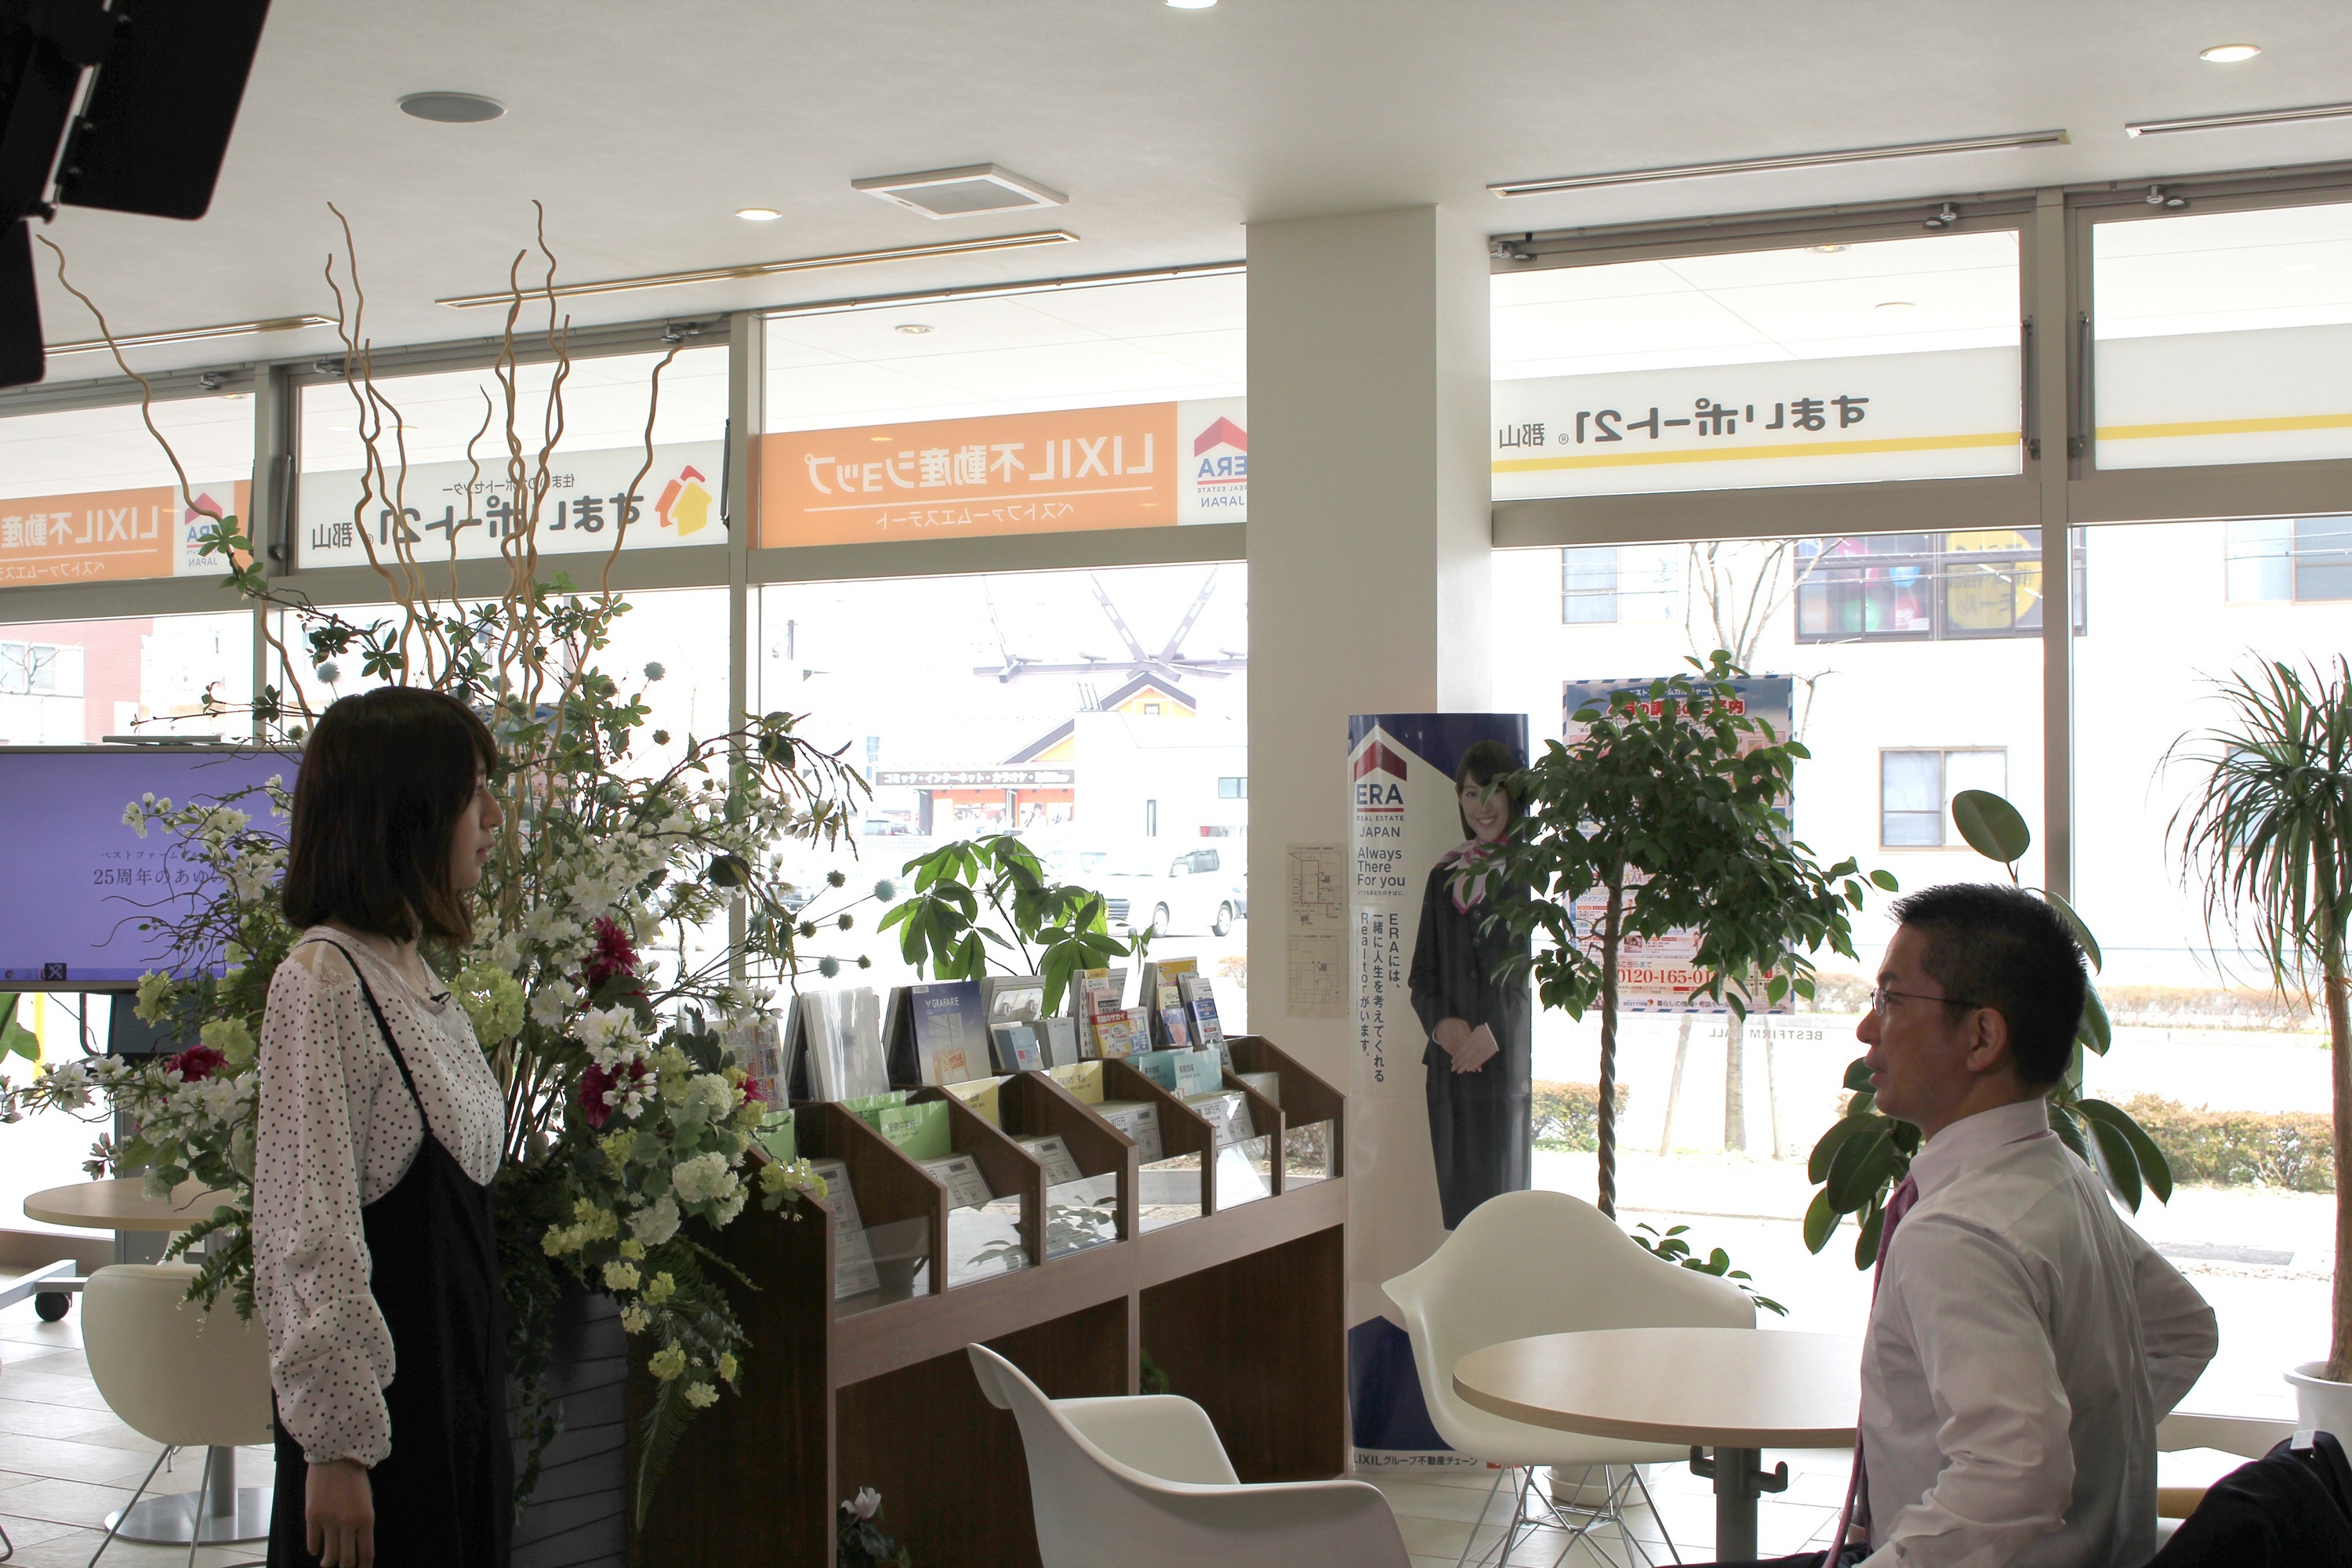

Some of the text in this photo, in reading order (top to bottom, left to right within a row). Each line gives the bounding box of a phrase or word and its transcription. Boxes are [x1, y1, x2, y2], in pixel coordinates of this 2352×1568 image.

[1356, 784, 1403, 805] ERA
[1359, 826, 1400, 838] JAPAN
[1358, 847, 1403, 862] Always
[1358, 861, 1392, 873] There
[1358, 874, 1406, 888] For you
[1618, 968, 1717, 984] 0120-165-01
[931, 996, 960, 1008] GRAFARE
[1373, 914, 1385, 1083] 一緒に人生を考えてくれる
